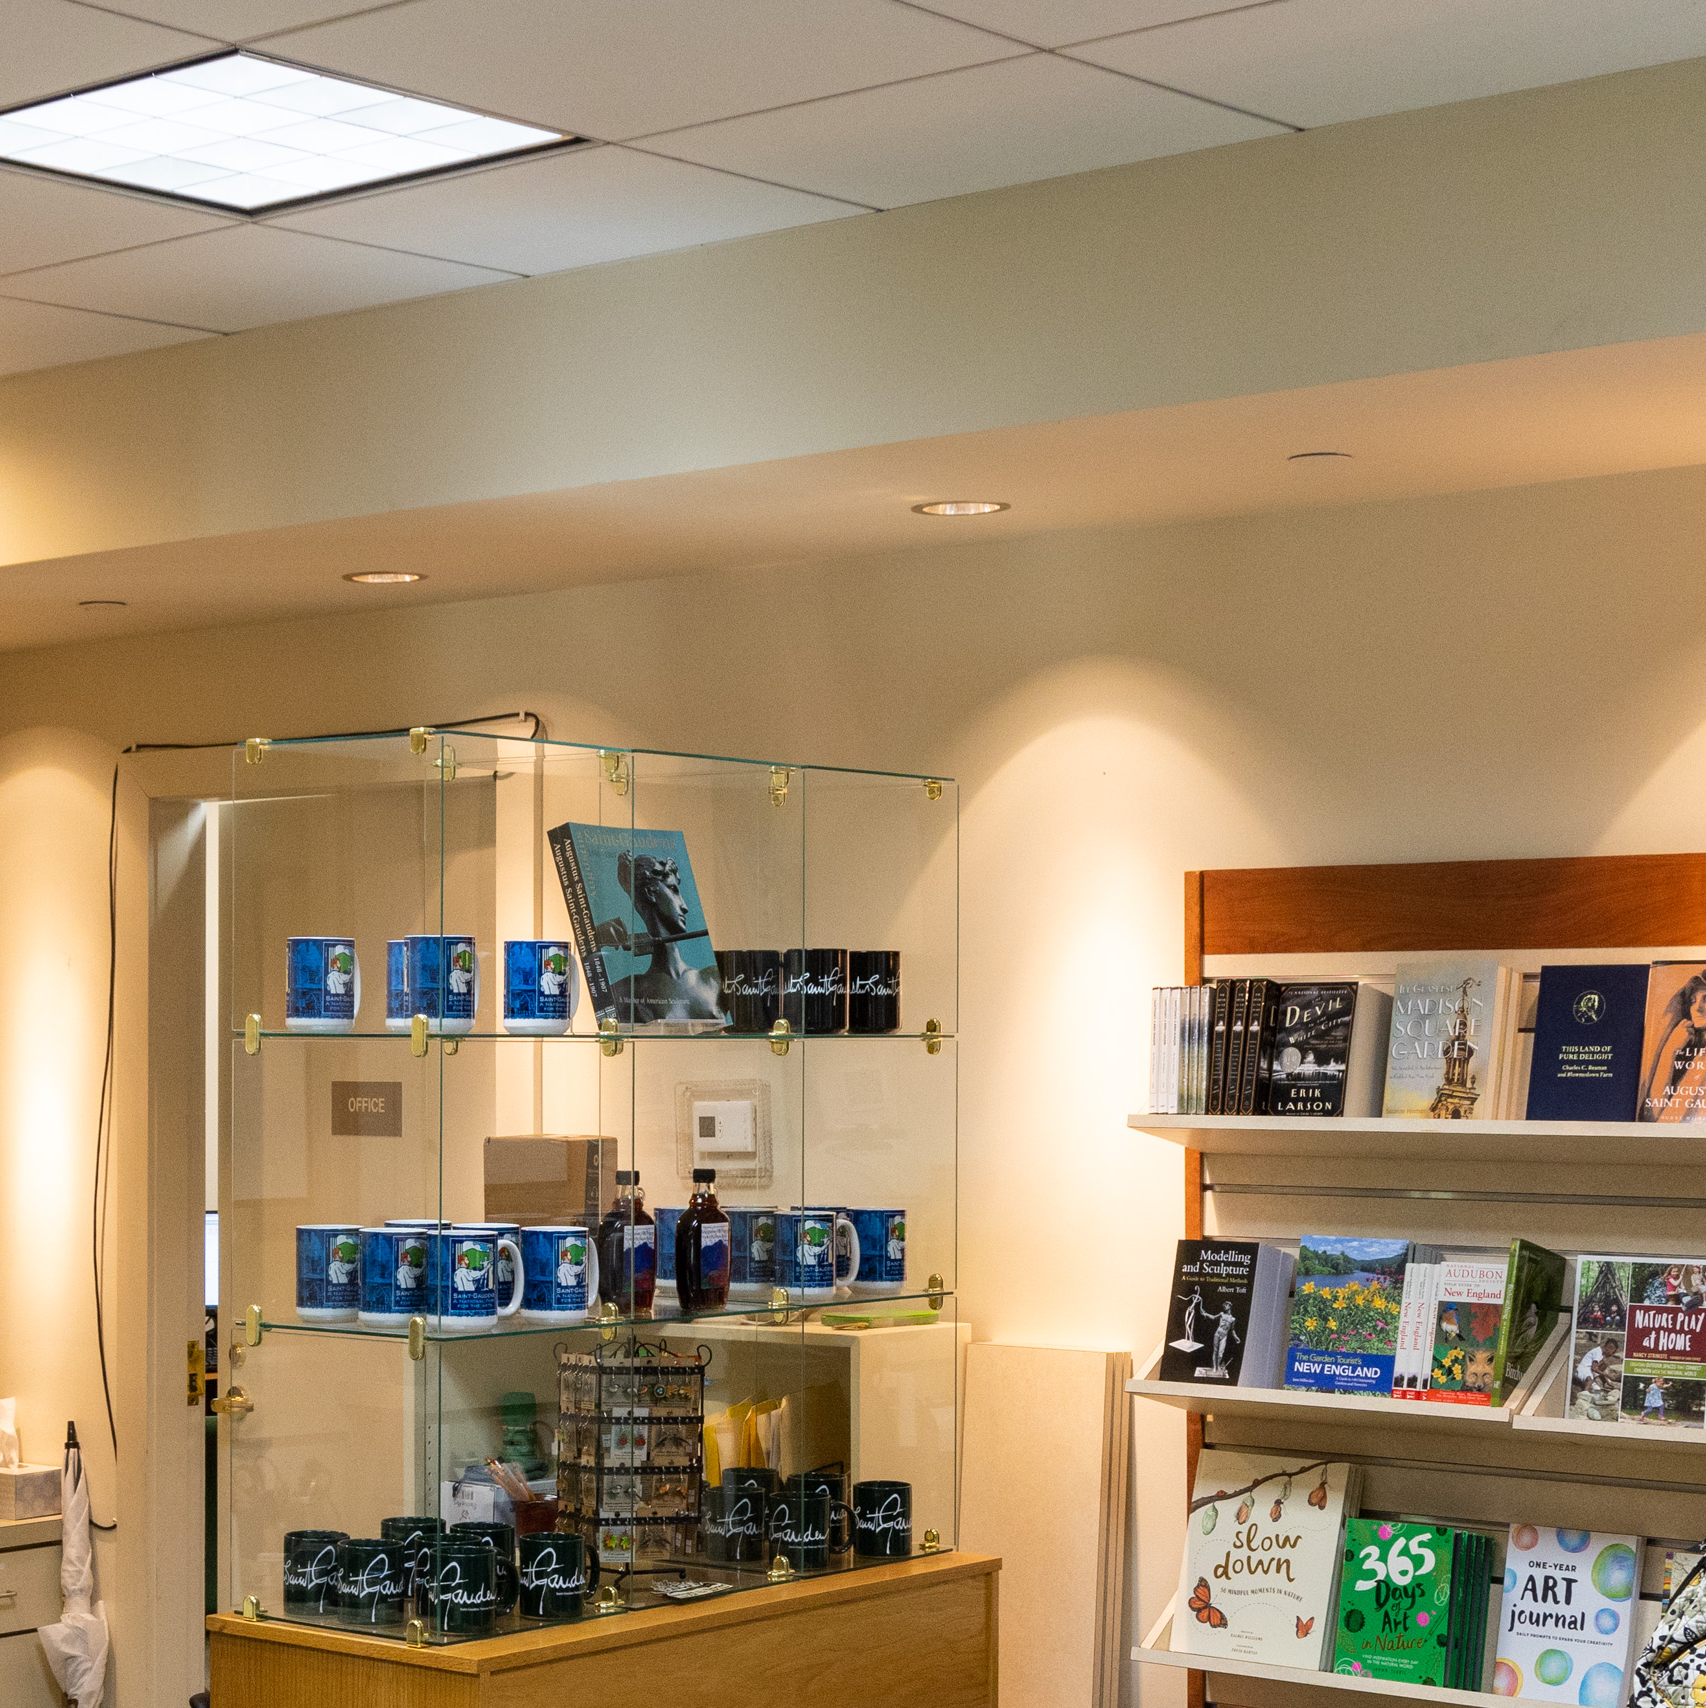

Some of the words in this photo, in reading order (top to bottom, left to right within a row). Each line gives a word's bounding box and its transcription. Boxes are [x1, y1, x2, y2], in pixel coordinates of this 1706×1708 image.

[553, 844, 569, 887] Augustus
[565, 888, 587, 958] Saint-Gaudens
[564, 838, 579, 882] Augustus
[576, 883, 597, 952] Saint-Gaudens
[1286, 996, 1343, 1028] DEVIL
[1395, 998, 1483, 1016] MADISON
[1289, 1030, 1316, 1044] WHITE
[1321, 1018, 1343, 1030] CITY
[1393, 1018, 1481, 1040] SQUARE
[1392, 1040, 1479, 1060] GARDEN
[1291, 1088, 1321, 1098] ERIK
[1645, 1098, 1685, 1108] SAINT
[349, 1098, 385, 1112] OFFICE
[1278, 1102, 1333, 1110] LARSON
[1200, 1250, 1251, 1264] Modelling
[1181, 1263, 1200, 1273] and
[1202, 1263, 1249, 1277] Sculpture
[1445, 1269, 1503, 1279] AUDUBON
[1444, 1288, 1463, 1298] New
[1467, 1288, 1501, 1300] England
[1403, 1302, 1411, 1319] New
[1417, 1303, 1425, 1320] New
[1635, 1310, 1673, 1328] NATURE
[1676, 1312, 1705, 1332] PLAY
[1399, 1320, 1409, 1350] England
[1413, 1320, 1423, 1350] England
[1643, 1331, 1657, 1349] at
[1659, 1330, 1691, 1351] HOME
[1295, 1352, 1309, 1360] The
[1310, 1354, 1335, 1362] Garden
[1337, 1356, 1362, 1365] Tourist's
[1294, 1362, 1322, 1374] NEW
[1324, 1364, 1381, 1378] ENGLAND
[1233, 1523, 1303, 1552] slow
[1213, 1550, 1295, 1582] down
[1355, 1532, 1435, 1591] 365
[1529, 1560, 1577, 1573] ONE-YEAR
[1374, 1580, 1426, 1613] Days
[1521, 1574, 1579, 1606] ART
[1381, 1610, 1410, 1634] Art
[1508, 1604, 1586, 1632] journal
[1361, 1638, 1372, 1650] in
[1375, 1632, 1425, 1652] Nature
[1587, 1639, 1613, 1647] CREATIVITY
